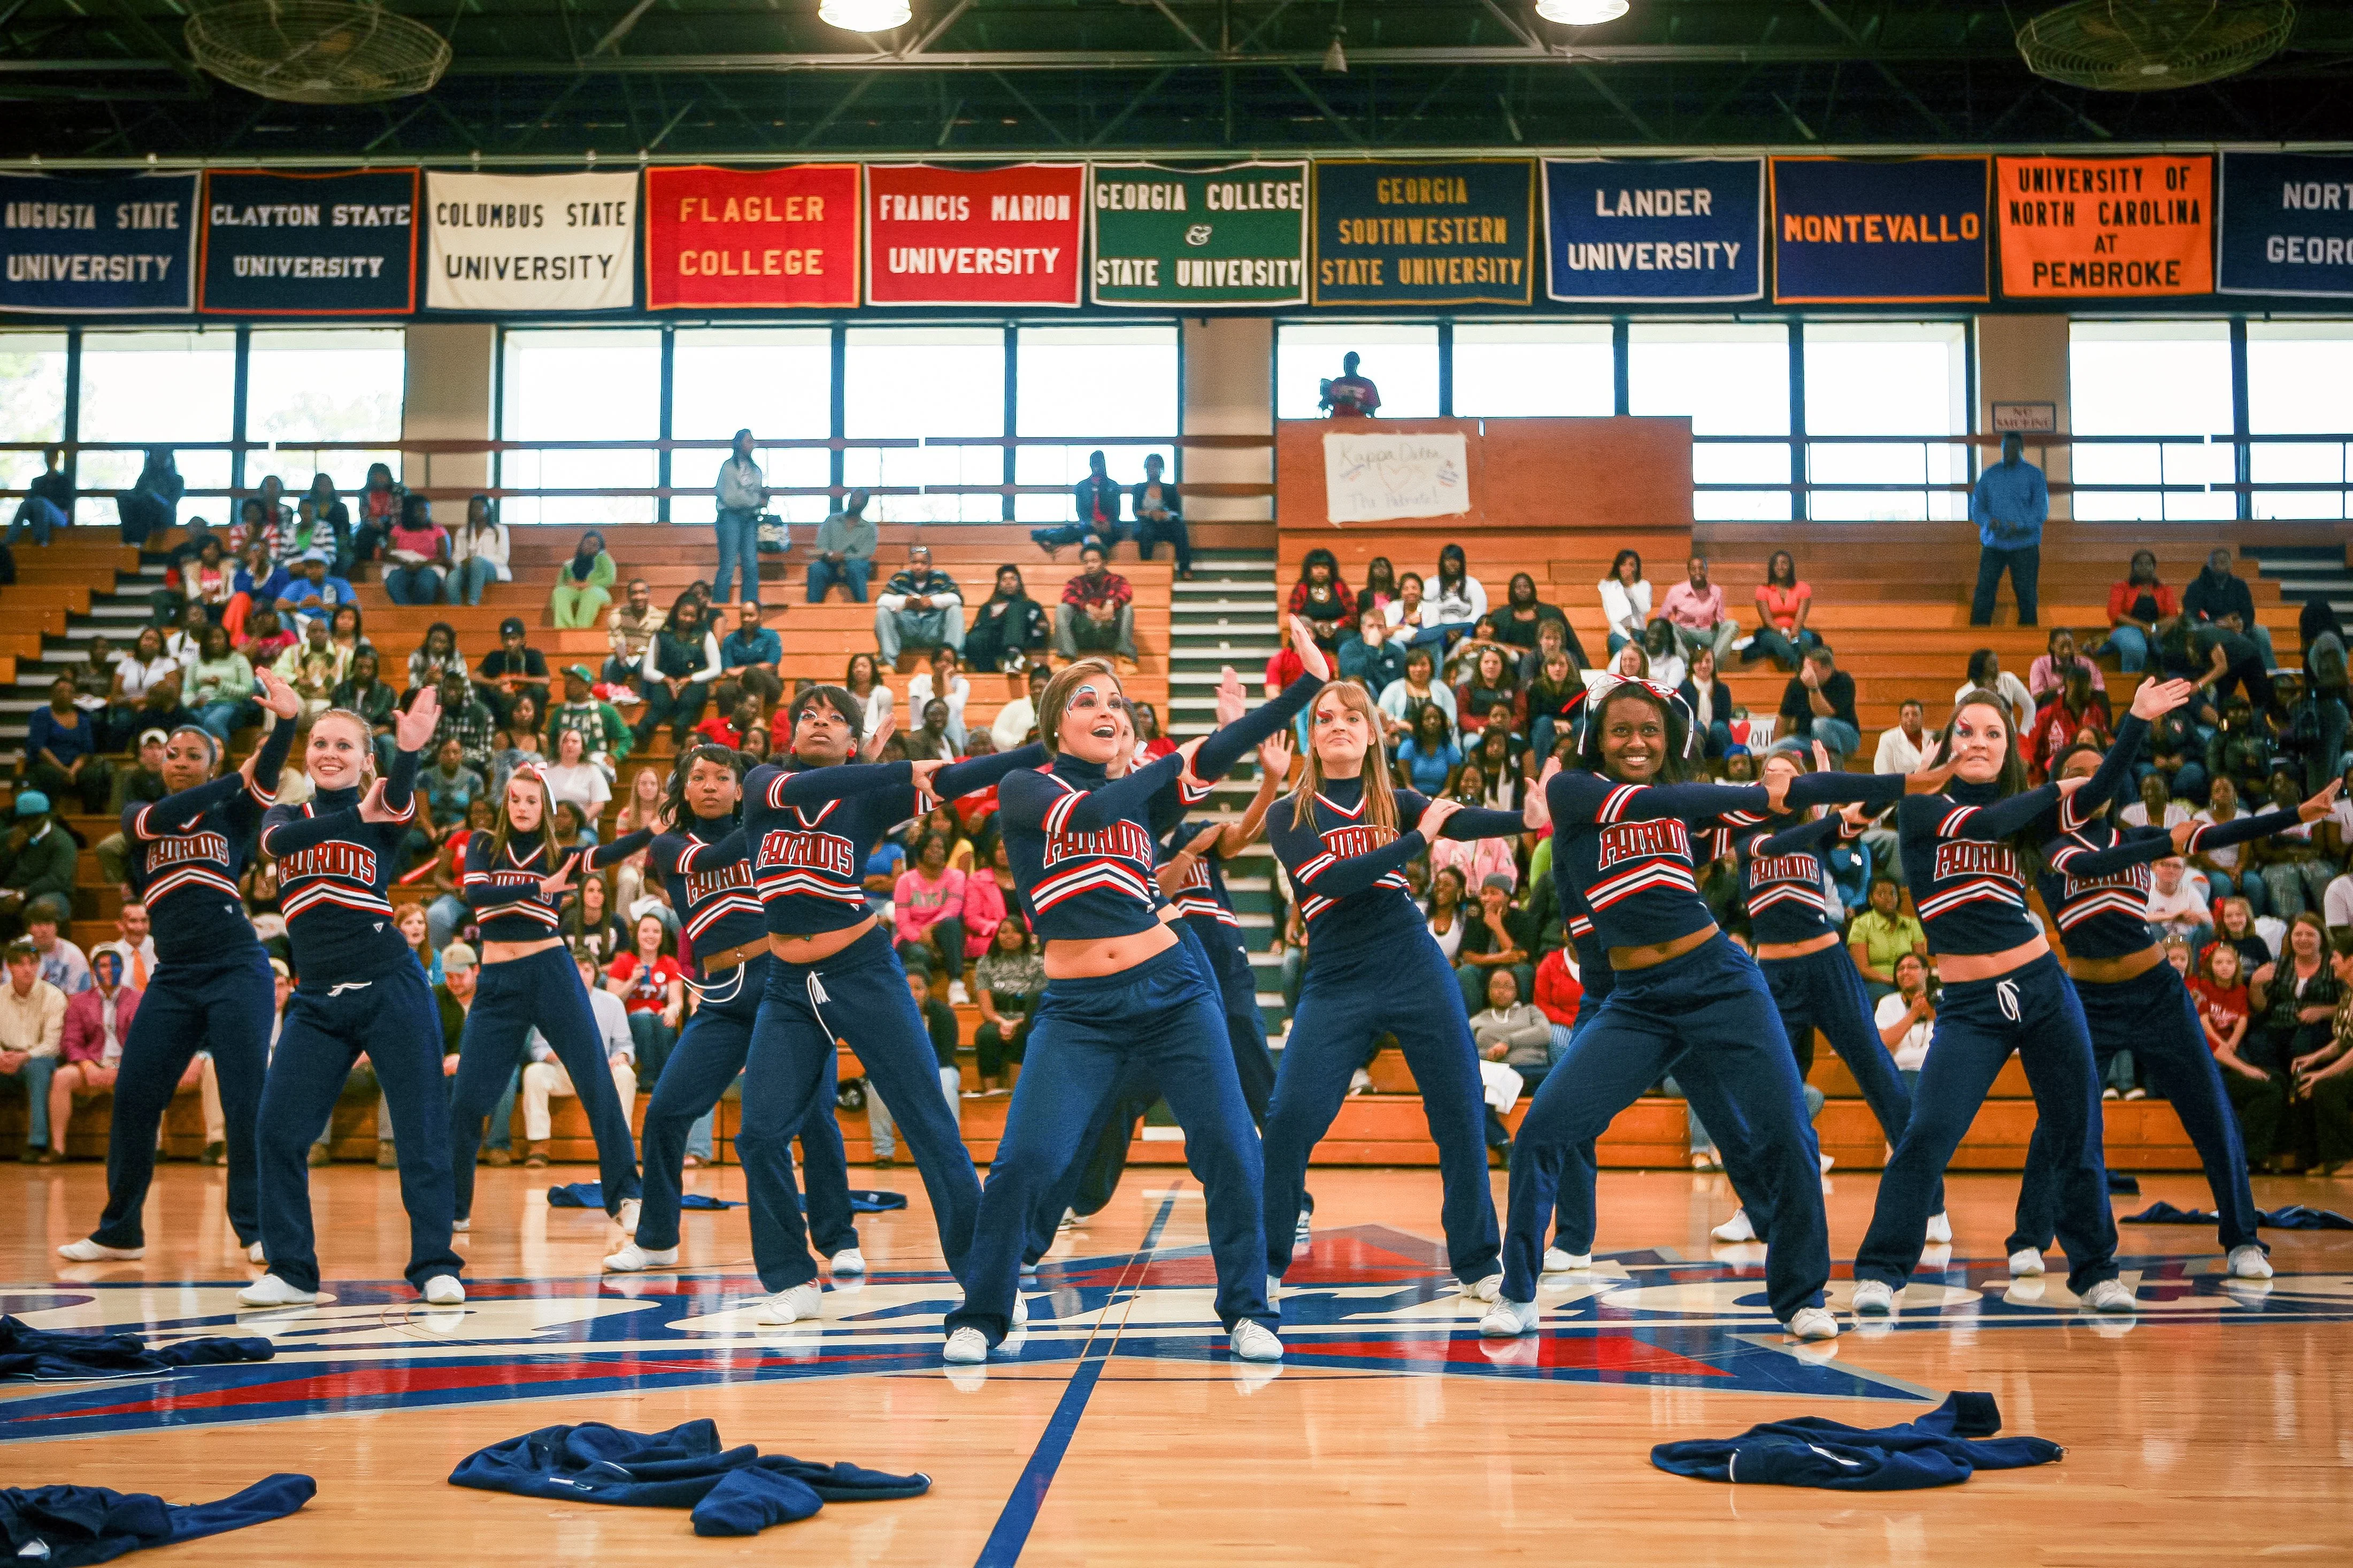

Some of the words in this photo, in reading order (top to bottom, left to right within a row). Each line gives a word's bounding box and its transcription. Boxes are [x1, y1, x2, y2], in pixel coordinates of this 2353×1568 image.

[1378, 179, 1467, 204] GEORGIA
[2019, 167, 2142, 192] UNIVERSITY
[2166, 166, 2190, 190] OF
[681, 197, 824, 222] FLAGLER
[881, 195, 969, 221] FRANCIS
[992, 196, 1070, 221] MARION
[1096, 184, 1186, 210] GEORGIA
[1208, 183, 1302, 210] COLLEGE
[1597, 190, 1711, 217] LANDER
[6, 203, 95, 229] AUGUSTA
[118, 203, 179, 229] STATE
[211, 205, 319, 226] CLAYTON
[333, 205, 410, 226] STATE
[437, 203, 543, 228] COLUMBUS
[567, 202, 625, 226] STATE
[2010, 201, 2074, 226] NORTH
[2099, 200, 2200, 225] CAROLINA
[1186, 226, 1212, 245] &
[1339, 218, 1506, 244] SOUTHWESTERN
[1785, 214, 1979, 242] MONTEVALLO
[1569, 243, 1740, 270] UNIVERSITY
[2095, 234, 2117, 253] AT
[7, 255, 170, 281] UNIVERSITY
[234, 257, 383, 277] UNIVERSITY
[447, 255, 612, 280] UNIVERSITY
[681, 250, 822, 275] COLLEGE
[890, 248, 1059, 274] UNIVERSITY
[1097, 259, 1158, 287] STATE
[1177, 260, 1301, 287] UNIVERSITY
[1321, 259, 1382, 285] STATE
[1399, 258, 1521, 284] UNIVERSITY
[2034, 261, 2180, 287] PEMBROKE
[279, 839, 376, 887] PATRIOTS
[756, 829, 854, 878] PATRIOTS
